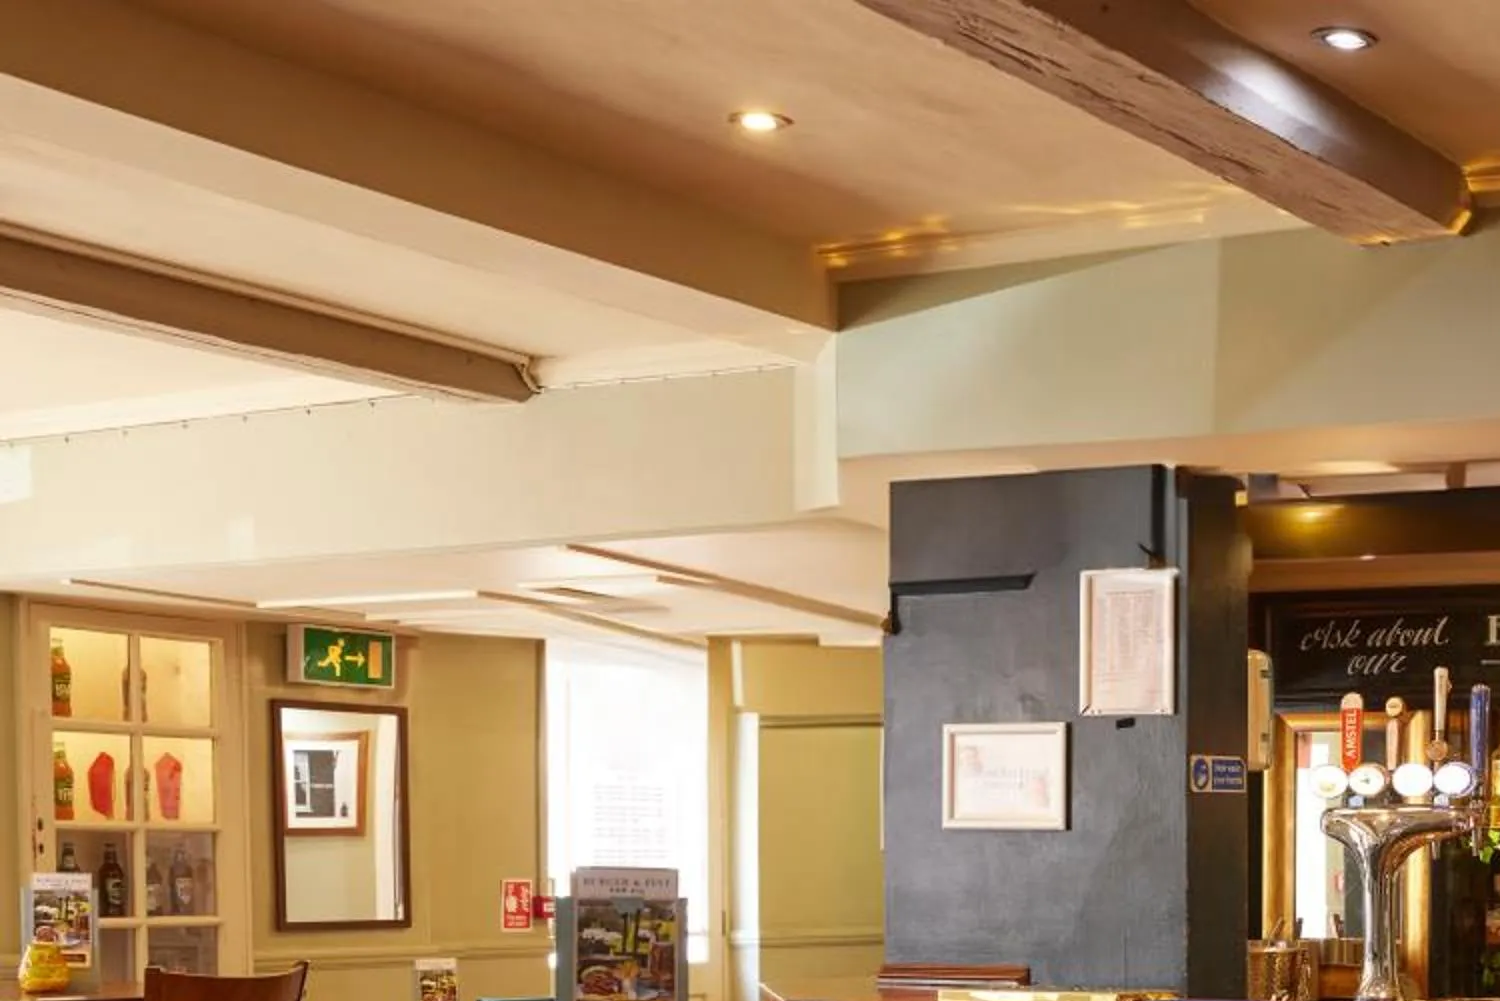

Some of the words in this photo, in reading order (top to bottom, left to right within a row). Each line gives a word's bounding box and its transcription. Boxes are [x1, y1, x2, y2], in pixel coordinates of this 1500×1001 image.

[1300, 619, 1361, 650] Ask
[1366, 615, 1449, 648] about
[1347, 651, 1407, 676] our
[1344, 710, 1360, 759] AMSTEL
